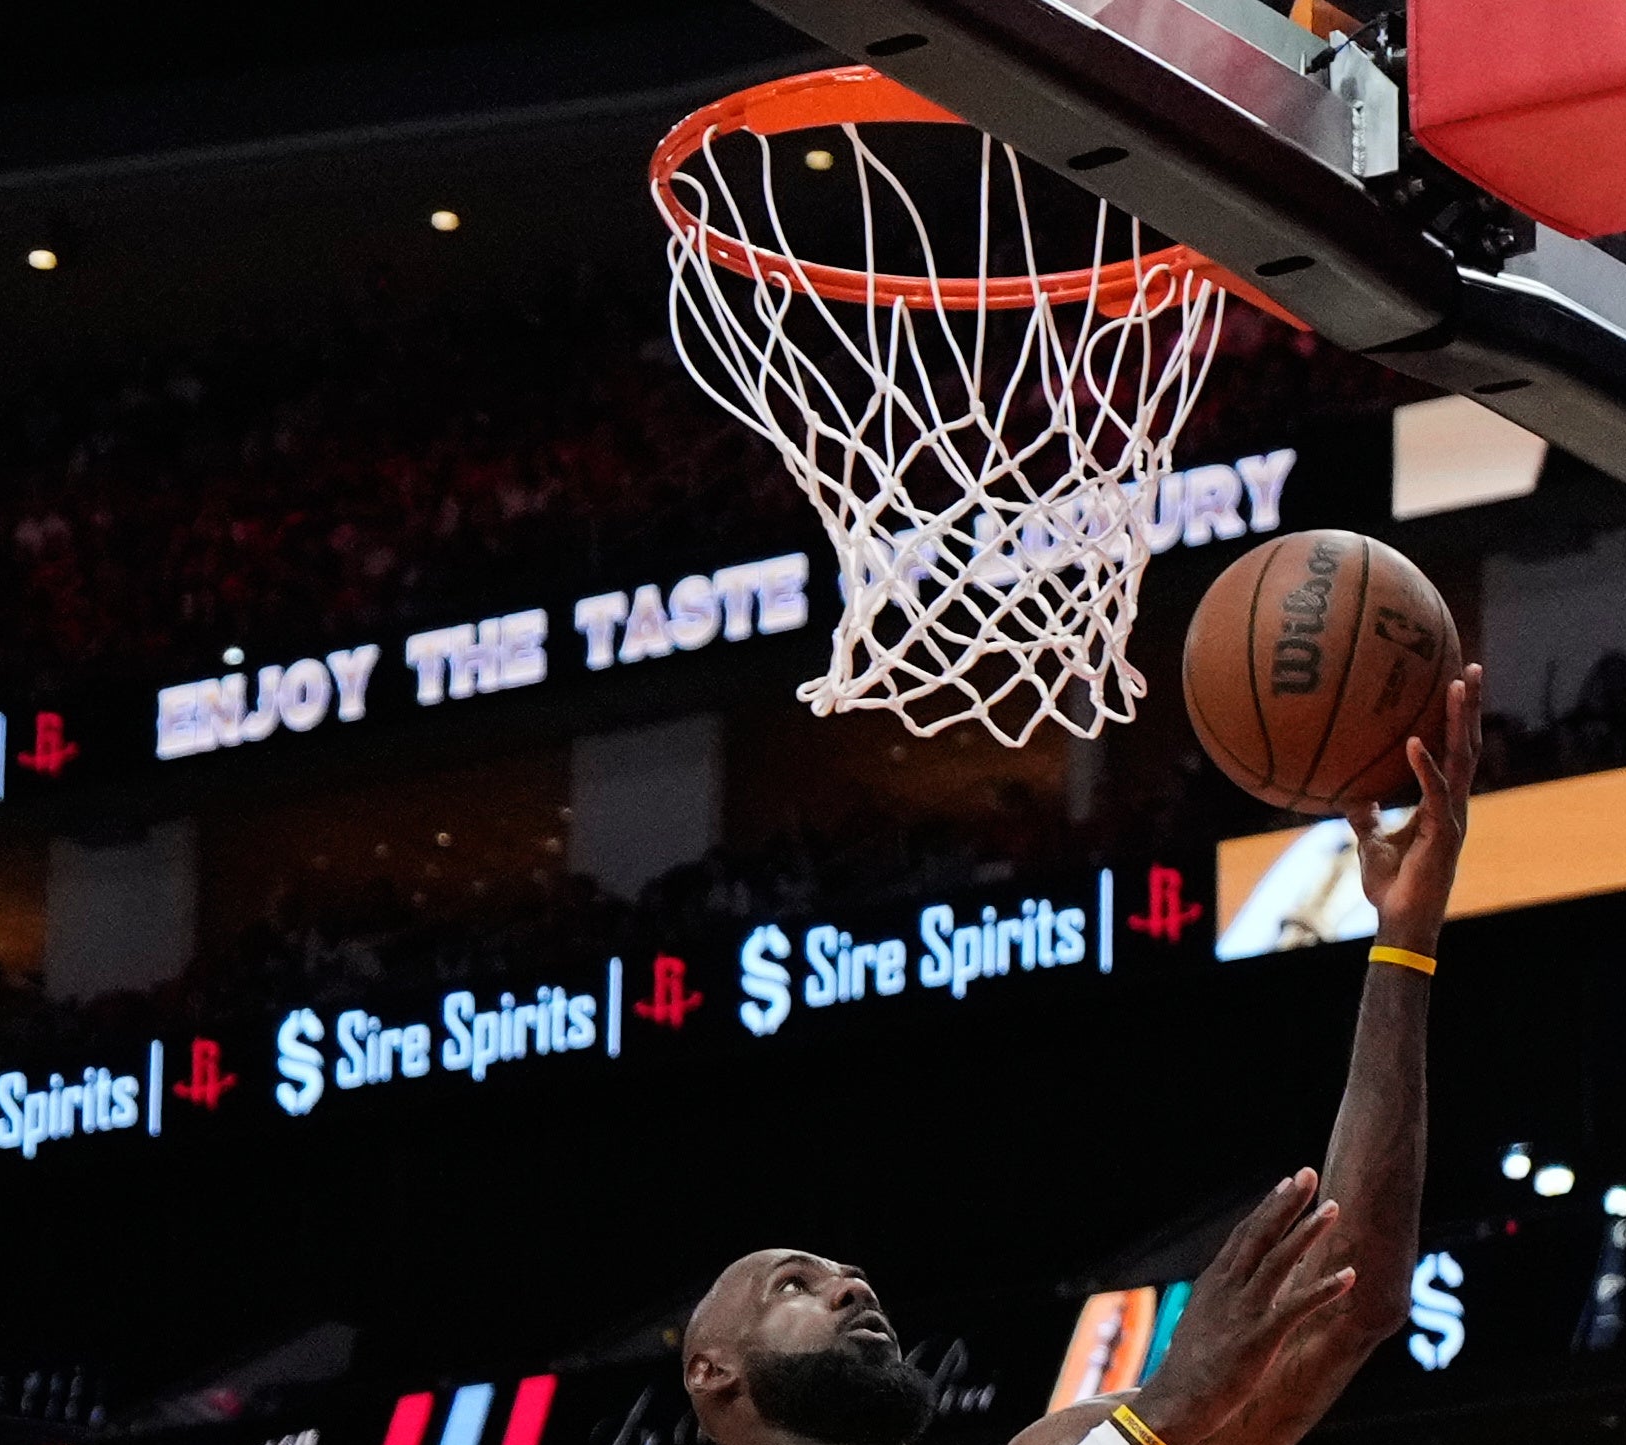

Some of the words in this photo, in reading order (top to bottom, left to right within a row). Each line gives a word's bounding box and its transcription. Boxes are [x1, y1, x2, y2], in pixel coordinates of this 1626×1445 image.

[156, 644, 379, 760] ENJOY
[406, 609, 547, 705] THE
[575, 552, 808, 670] TASTE
[804, 925, 906, 1007] Sire
[919, 899, 1085, 999] Spirits
[335, 1010, 430, 1089] Sire
[442, 986, 596, 1081] Spirits
